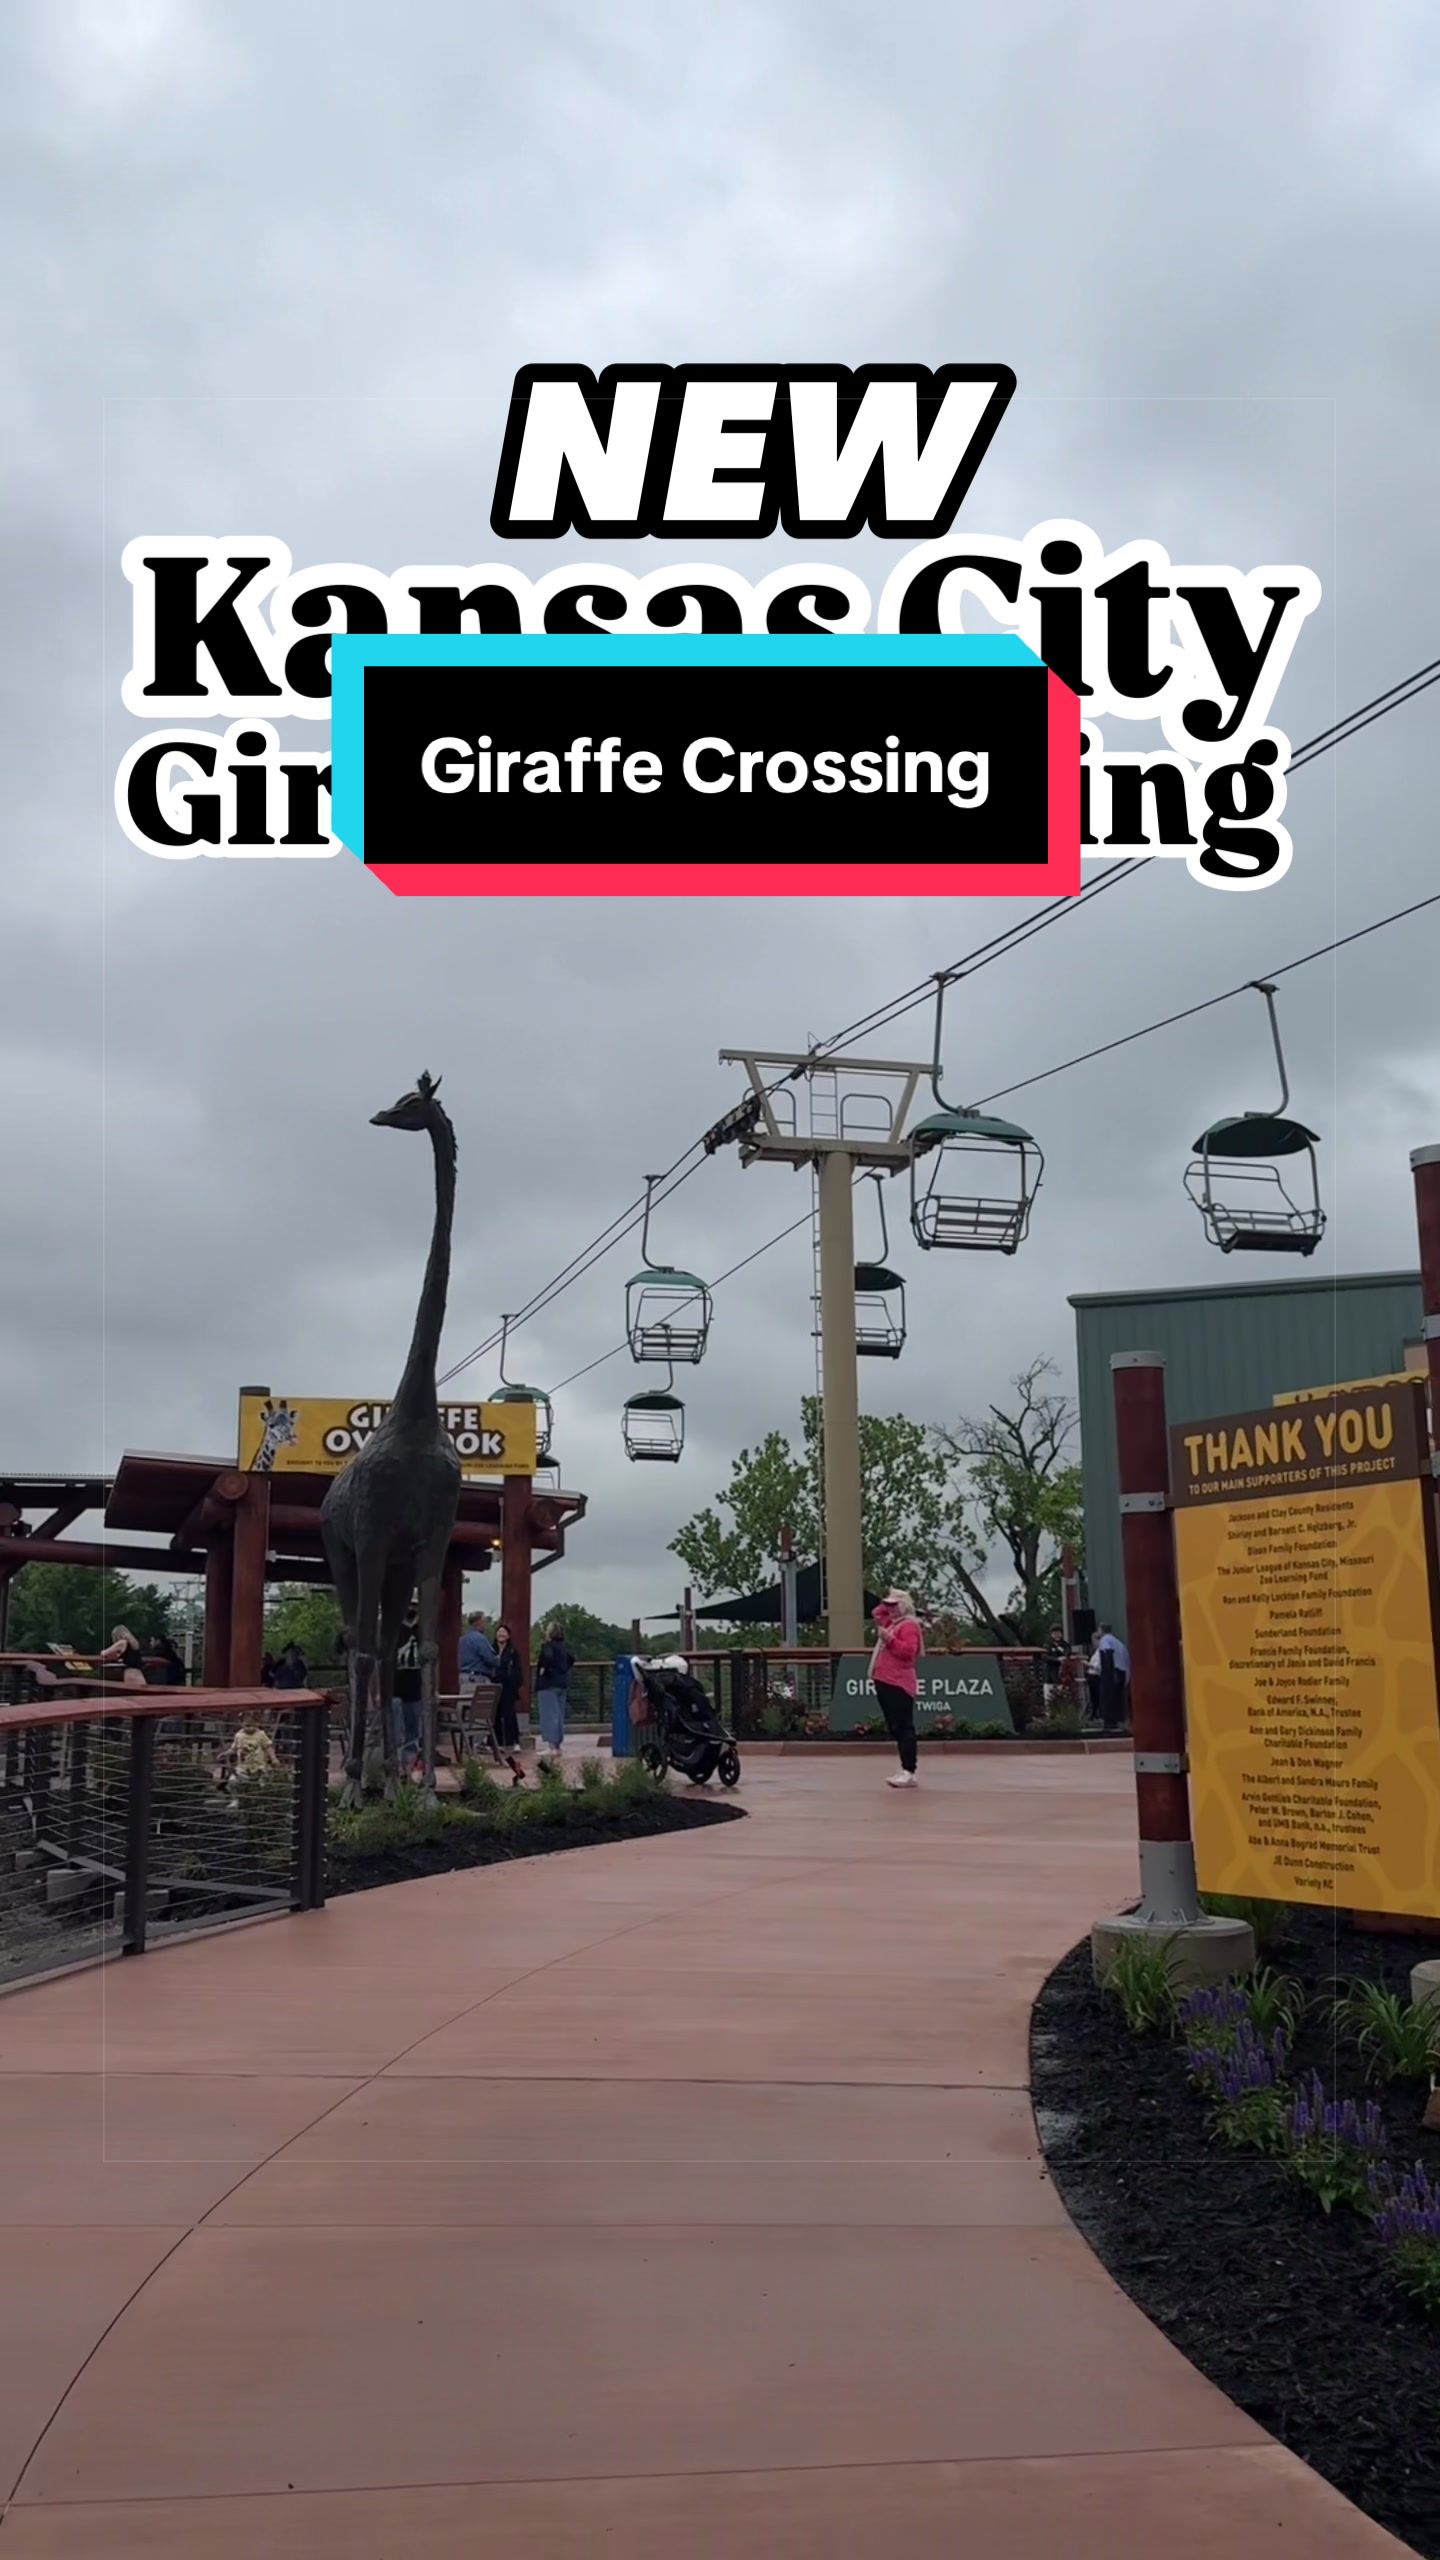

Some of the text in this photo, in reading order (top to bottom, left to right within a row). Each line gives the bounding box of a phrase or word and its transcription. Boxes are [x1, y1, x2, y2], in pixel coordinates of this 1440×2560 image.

[350, 1405, 479, 1430] GIFE
[1184, 1402, 1394, 1477] THANK YOU
[1188, 1457, 1396, 1496] TO OUR MAIN SUPPORTERS OF THIS PROJECT
[1269, 1543, 1292, 1554] Family
[1294, 1539, 1336, 1551] Foundation
[1217, 1554, 1374, 1576] The Junior League of Kansas City, Missouri
[1260, 1571, 1328, 1585] Zoo Learning Fund
[1302, 1589, 1327, 1601] Family
[1328, 1587, 1372, 1598] Foundation
[1254, 1626, 1342, 1639] Sunderland Foundation
[846, 1679, 993, 1696] GIRE PLAZA
[1323, 1676, 1350, 1687] Family
[915, 1701, 951, 1711] TWIGA
[1336, 1726, 1362, 1739] Family
[1264, 1738, 1348, 1749] Charitable Foundation
[1351, 1778, 1378, 1791] Family
[1304, 1858, 1355, 1872] Construction
